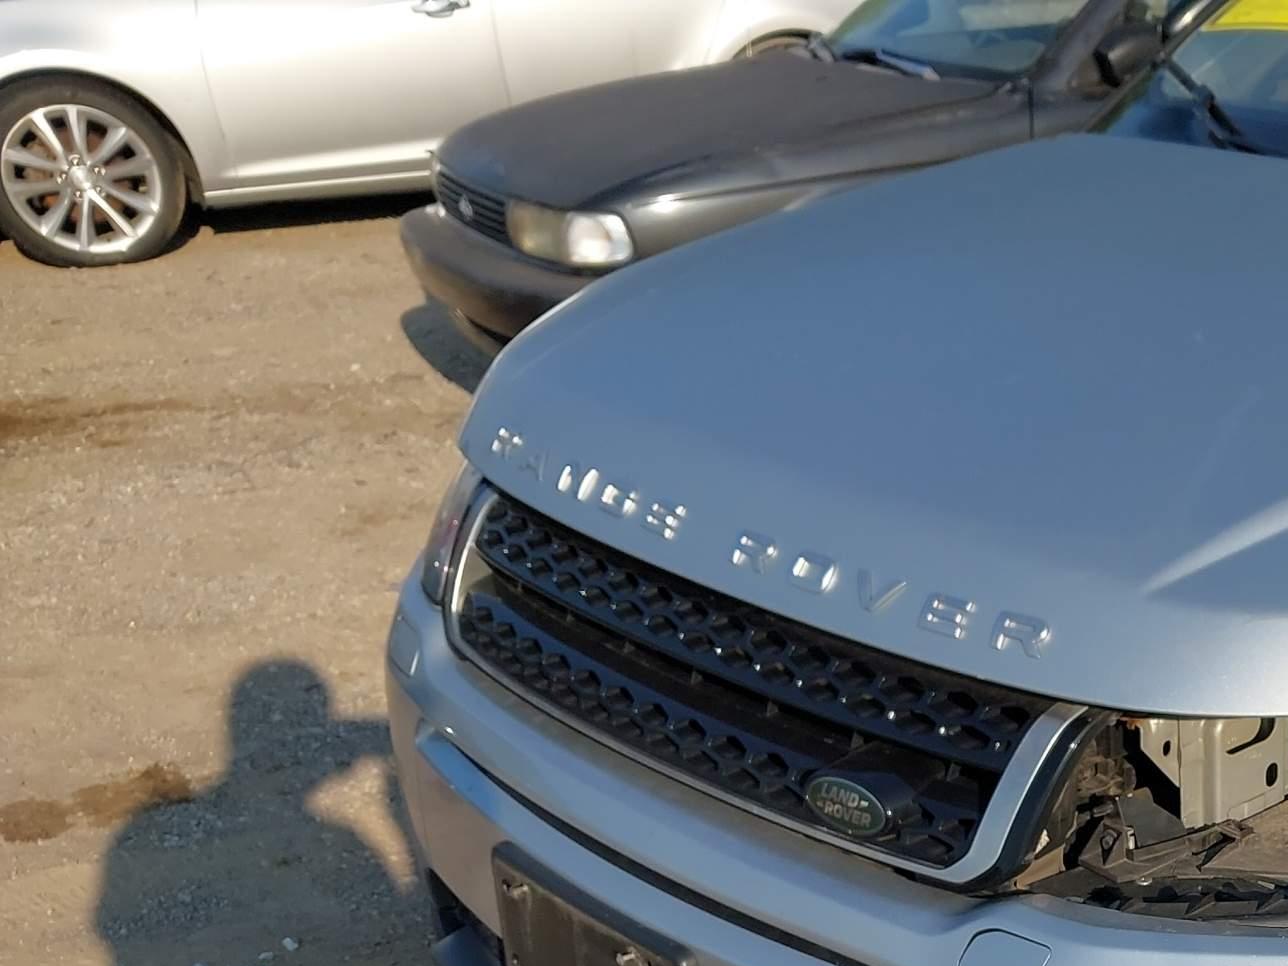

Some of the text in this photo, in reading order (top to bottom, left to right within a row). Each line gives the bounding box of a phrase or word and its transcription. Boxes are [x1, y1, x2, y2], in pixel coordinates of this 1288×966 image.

[729, 529, 1053, 661] ROVER
[819, 783, 861, 808] LAND
[823, 801, 873, 828] ROVER
